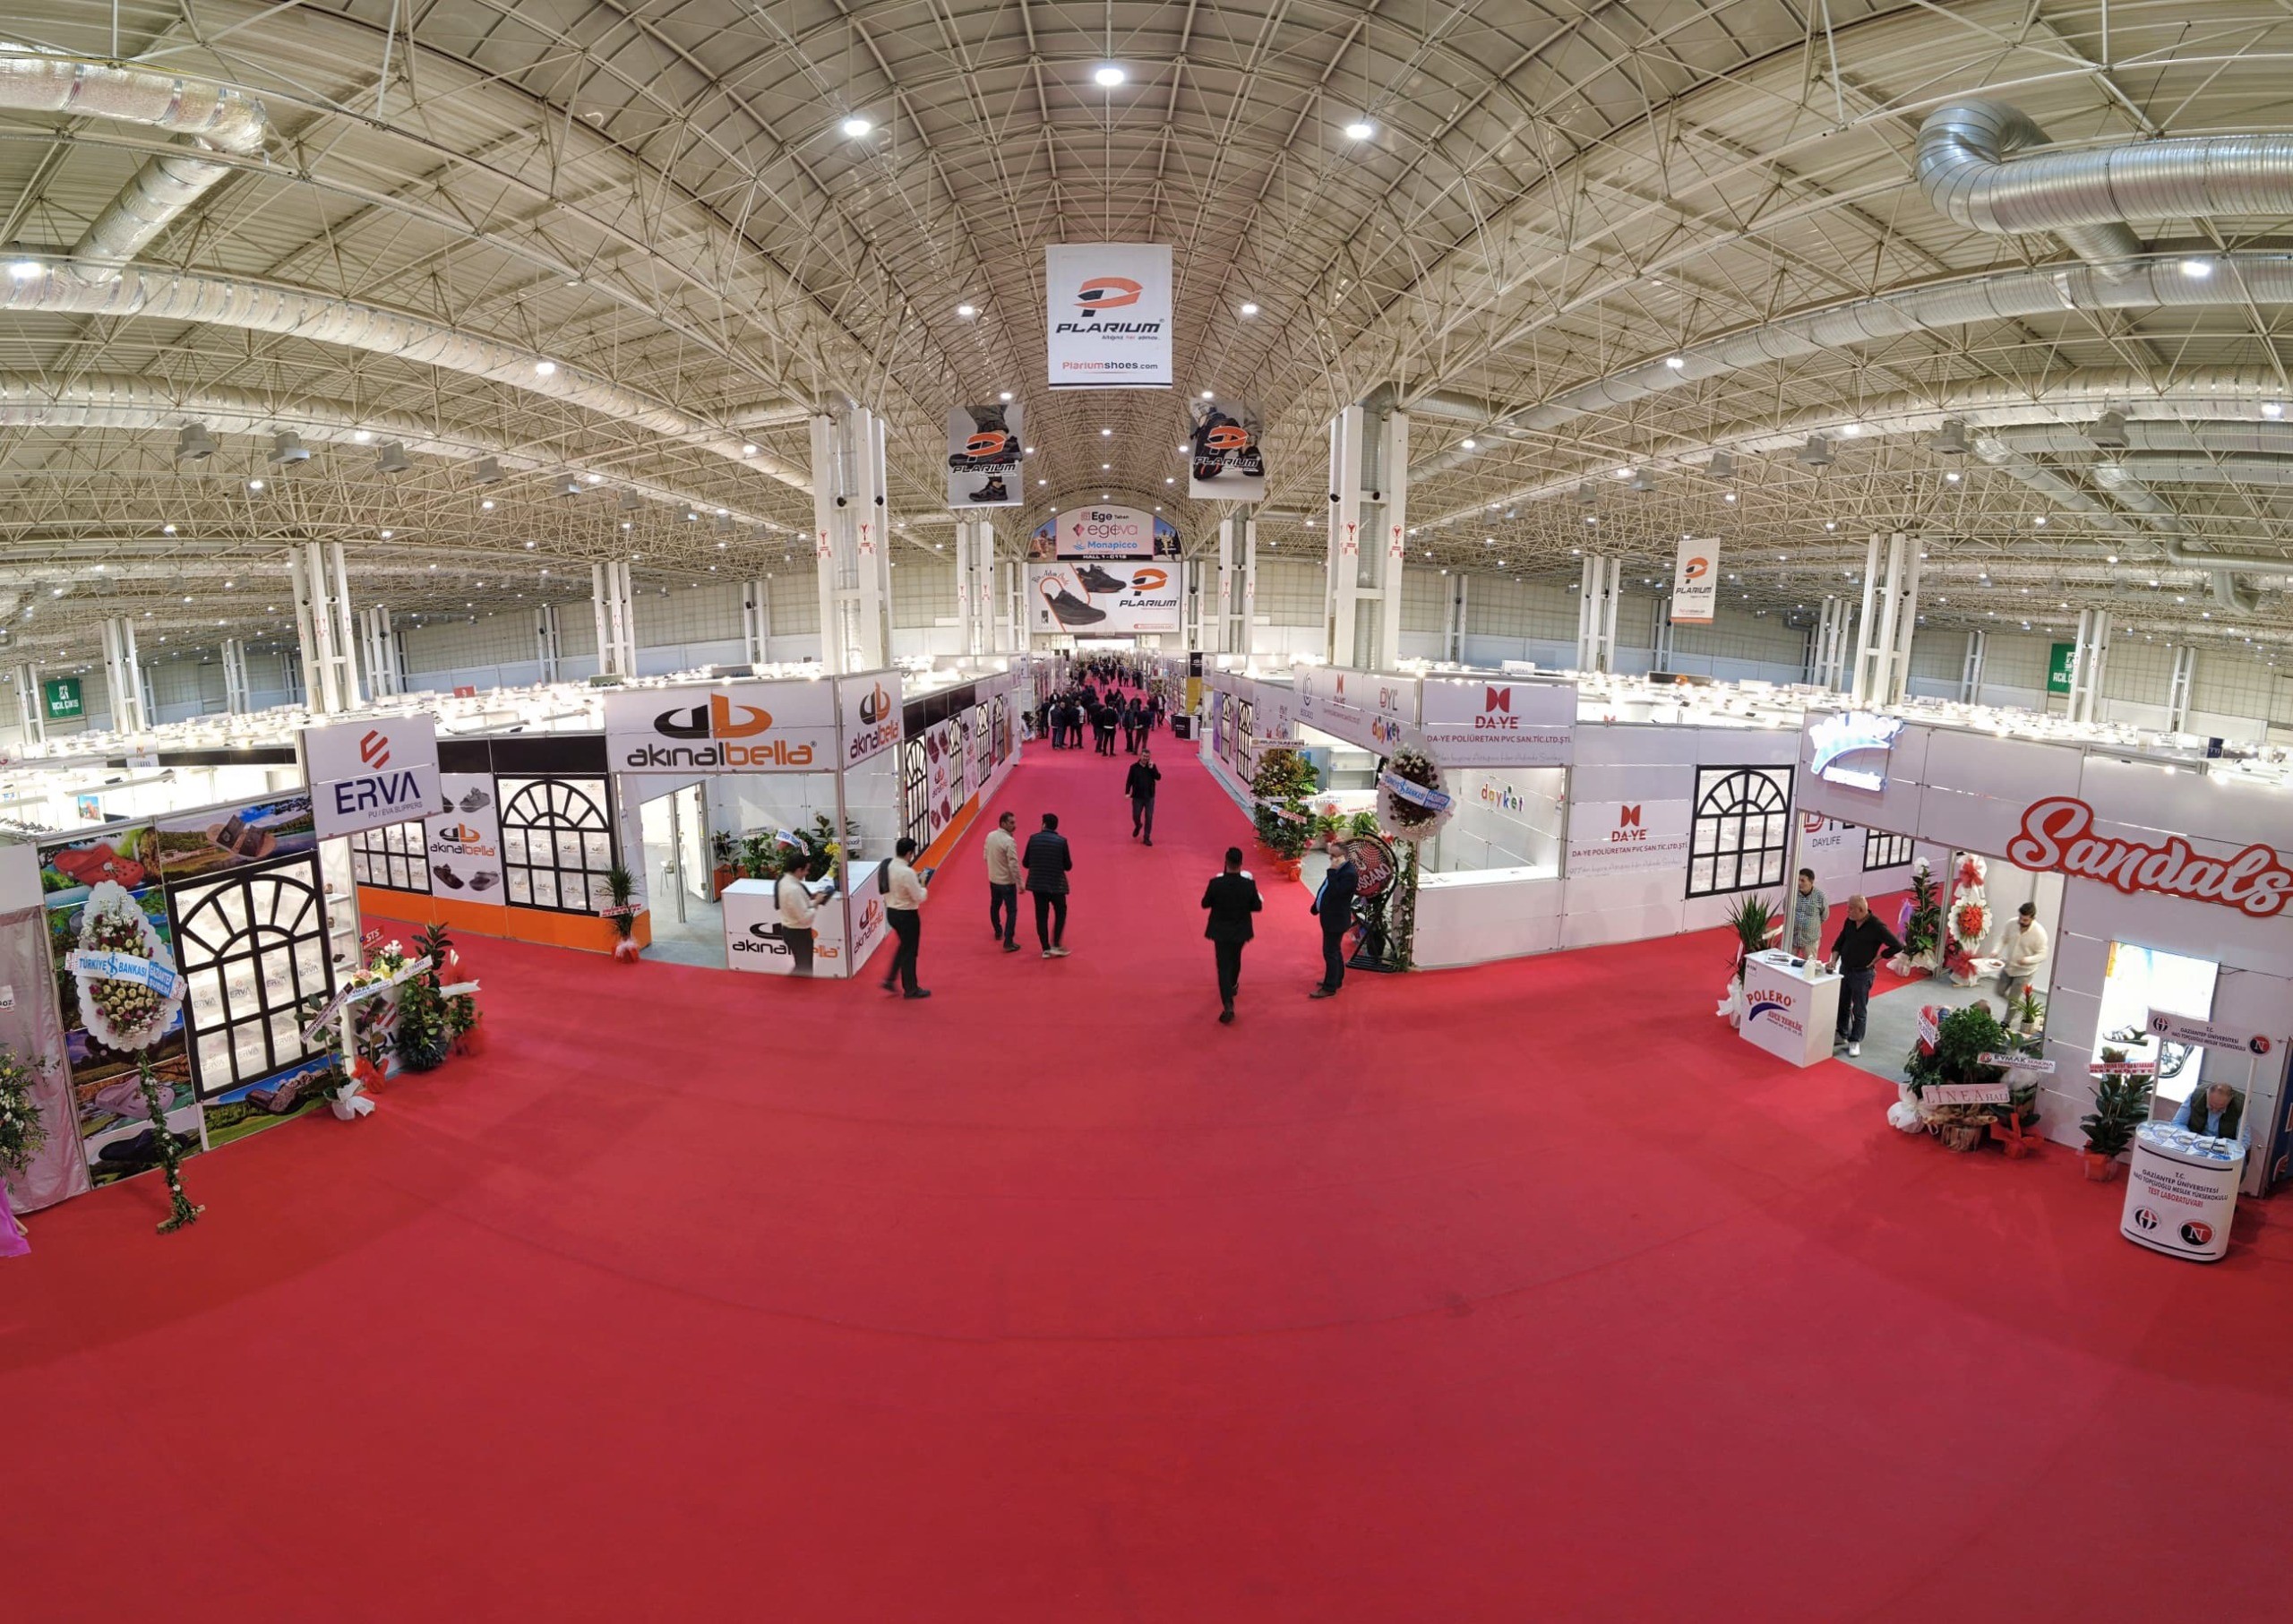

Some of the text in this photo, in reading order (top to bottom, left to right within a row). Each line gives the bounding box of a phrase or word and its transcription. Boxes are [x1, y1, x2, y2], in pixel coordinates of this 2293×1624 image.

[1056, 322, 1161, 333] PLARIUM
[1062, 361, 1158, 370] Plariumshoes.com
[1195, 456, 1258, 468] PLARIUM
[952, 464, 1016, 474] PLARIUM
[1091, 511, 1112, 522] Ege
[1087, 524, 1138, 538] egeva
[1087, 541, 1138, 552] Monapicco
[1475, 716, 1519, 729] DA-YE
[334, 771, 421, 815] ERVA
[1481, 783, 1524, 812] dayket
[368, 810, 378, 819] PU
[382, 806, 394, 816] EVA
[395, 801, 423, 813] SLIPPERS
[1612, 829, 1646, 842] DA-YE
[1812, 836, 1842, 847] DAYLIFE
[1572, 849, 1591, 857] DA-YE
[2012, 801, 2293, 913] Sandals
[365, 928, 380, 941] STS
[79, 957, 146, 976] TÜRKİYE BANKASI
[229, 986, 251, 999] ERVA
[1746, 990, 1791, 1007] POLERO
[1994, 1053, 2027, 1064] EYMAK
[2142, 1169, 2220, 1193] GAZİANTEP ÜNİVERSİTESİ
[2175, 1172, 2186, 1180] T.C.
[2148, 1187, 2203, 1208] TEST LABORATUVARI
[2172, 1186, 2191, 1196] MESLEK
[2192, 1190, 2229, 1201] YÜKSEKOKULU
